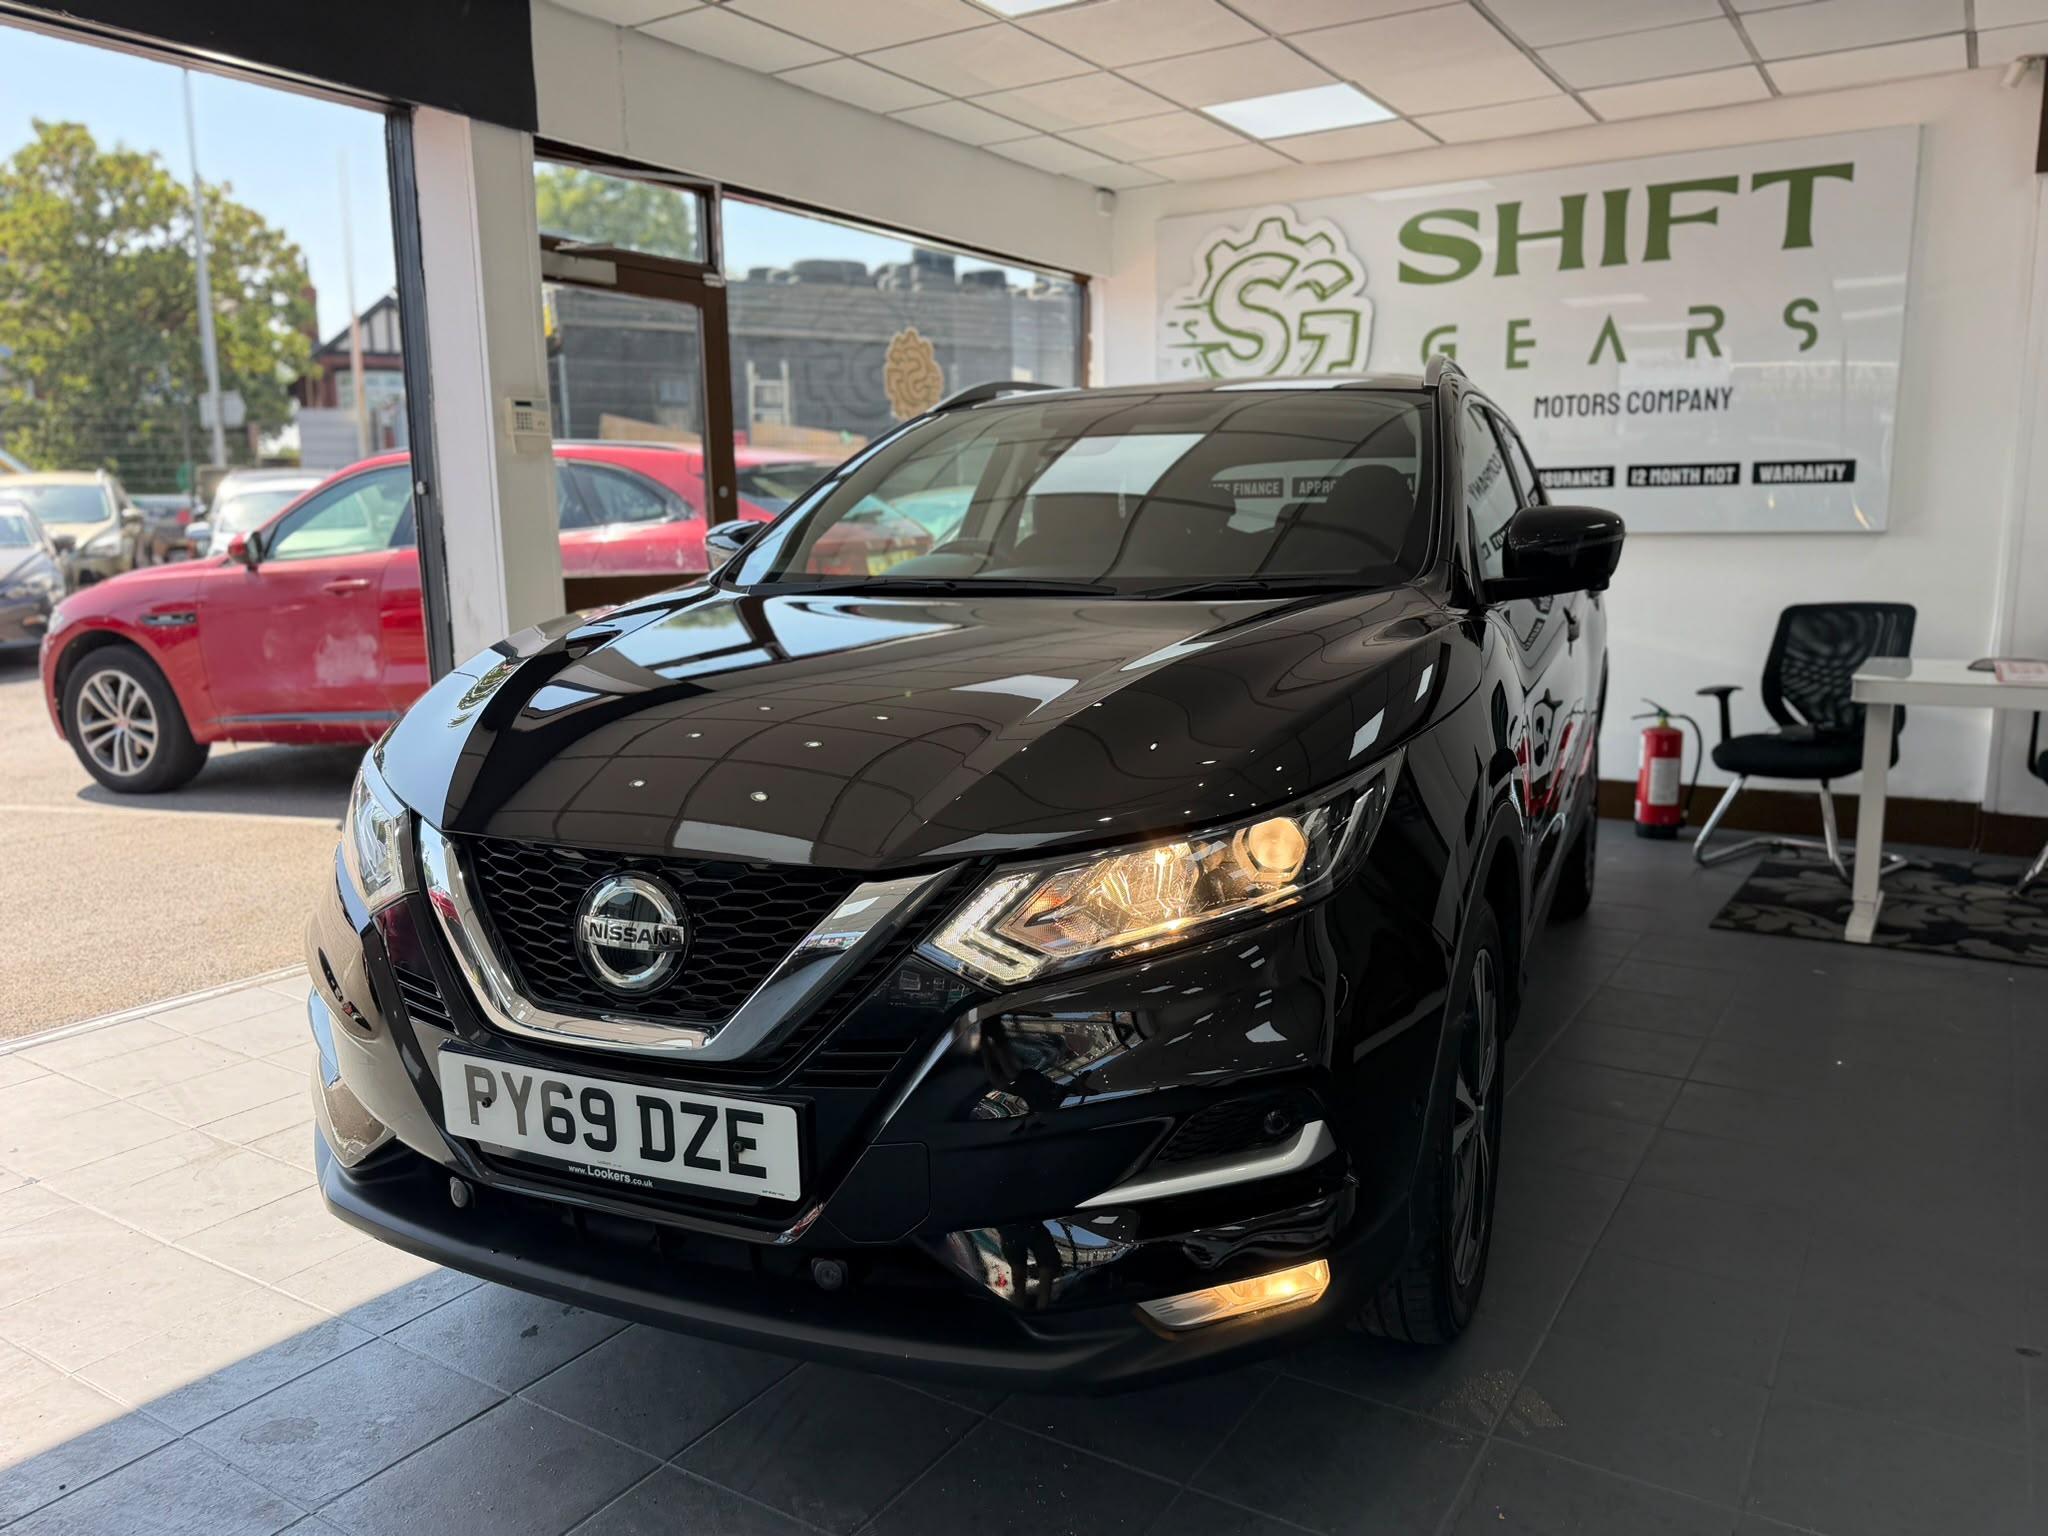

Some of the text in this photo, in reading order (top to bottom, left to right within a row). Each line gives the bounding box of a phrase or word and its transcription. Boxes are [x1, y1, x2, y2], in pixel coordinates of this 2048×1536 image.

[1397, 163, 1855, 286] SHIFT
[1421, 298, 1820, 370] GEARS
[1533, 387, 1734, 419] MOTORS COMPANY
[1232, 481, 1280, 496] FINANCE
[1299, 480, 1336, 494] APPR
[1540, 470, 1610, 487] SURANCE
[1630, 468, 1647, 485] 12
[1651, 467, 1700, 485] MONTH
[1703, 465, 1736, 483] MOT
[1758, 464, 1847, 482] WARRANTY
[589, 921, 671, 946] NISSAN
[464, 1063, 767, 1179] PY69 DZE
[568, 1164, 653, 1188] www.Lookers.co.uk
